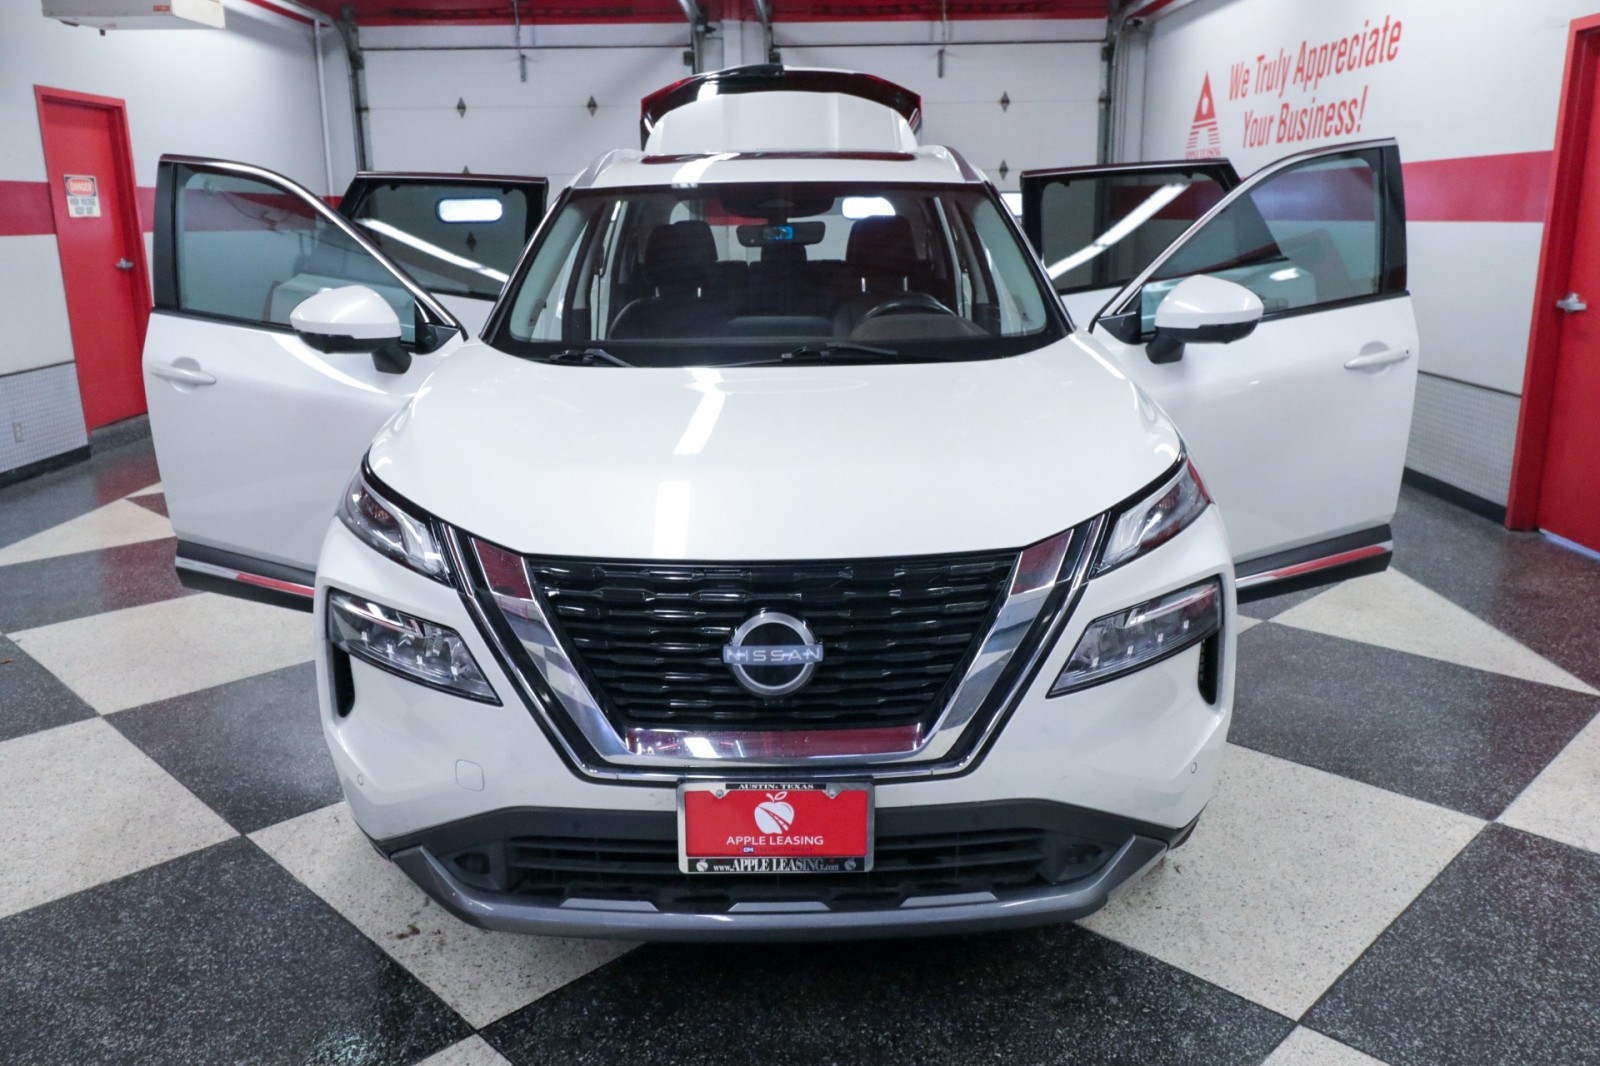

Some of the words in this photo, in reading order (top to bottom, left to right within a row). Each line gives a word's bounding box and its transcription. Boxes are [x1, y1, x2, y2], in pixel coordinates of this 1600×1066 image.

[1228, 60, 1250, 101] We
[1254, 48, 1292, 99] Truly
[1292, 14, 1403, 93] Appreciate
[1242, 109, 1275, 149] Your
[1275, 84, 1369, 145] Business!
[69, 181, 93, 192] DANGER
[726, 647, 820, 662] NISSAN
[726, 836, 767, 846] APPLE
[769, 835, 824, 846] LEASING
